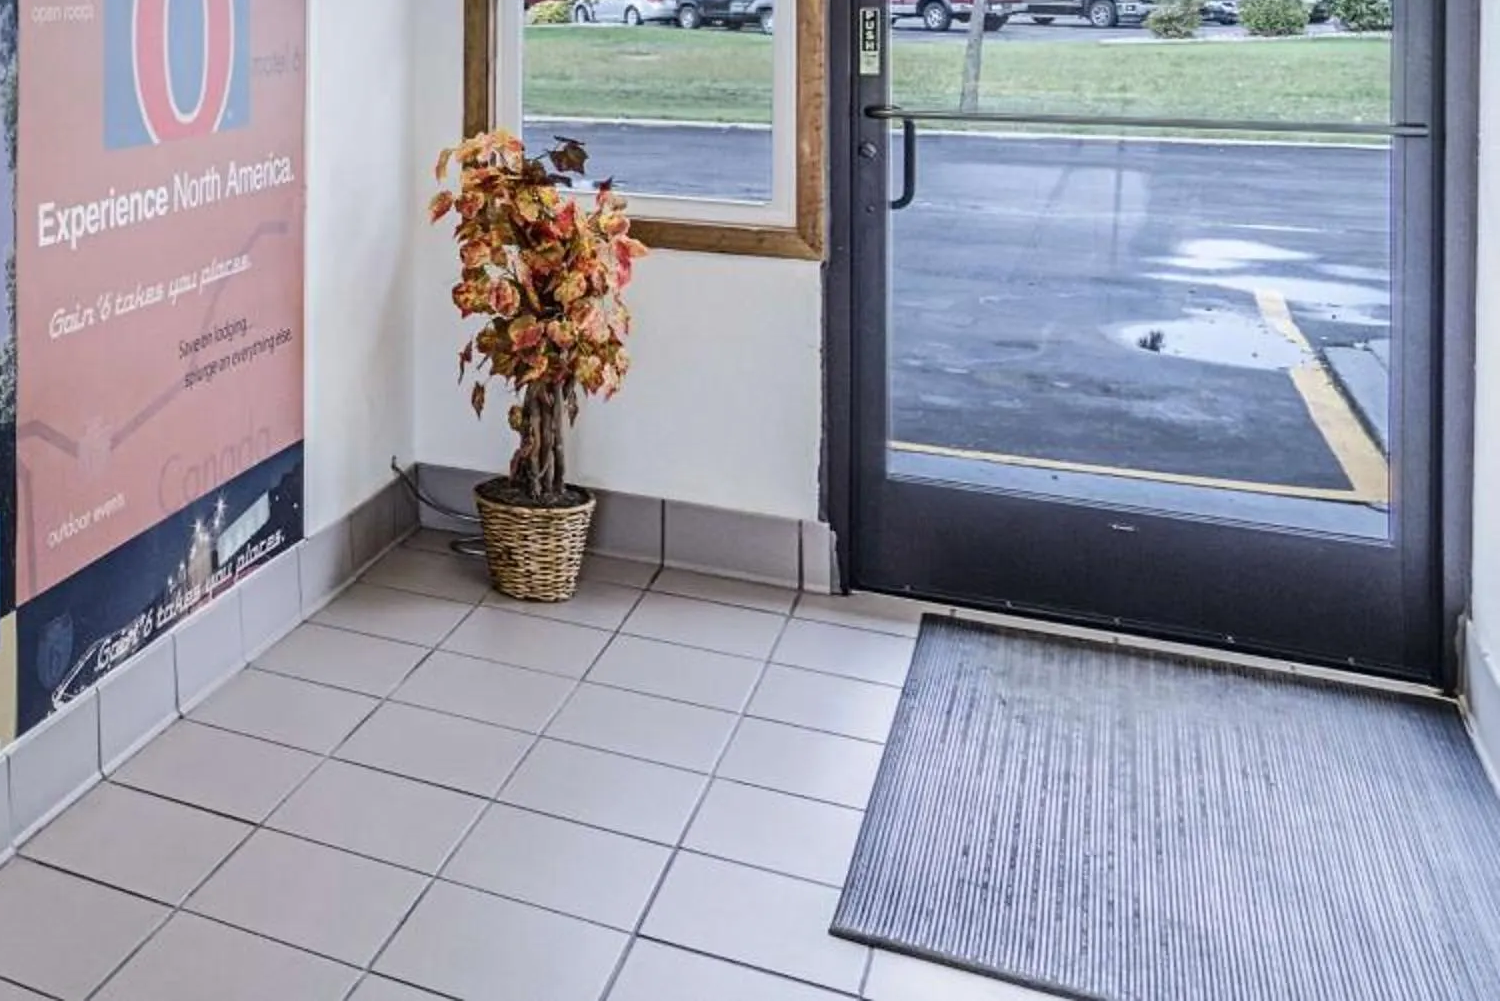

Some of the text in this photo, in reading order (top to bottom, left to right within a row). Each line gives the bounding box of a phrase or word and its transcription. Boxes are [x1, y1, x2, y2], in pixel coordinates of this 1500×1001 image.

[38, 152, 294, 250] Experience North America.
[114, 282, 165, 317] takes
[167, 270, 198, 306] you
